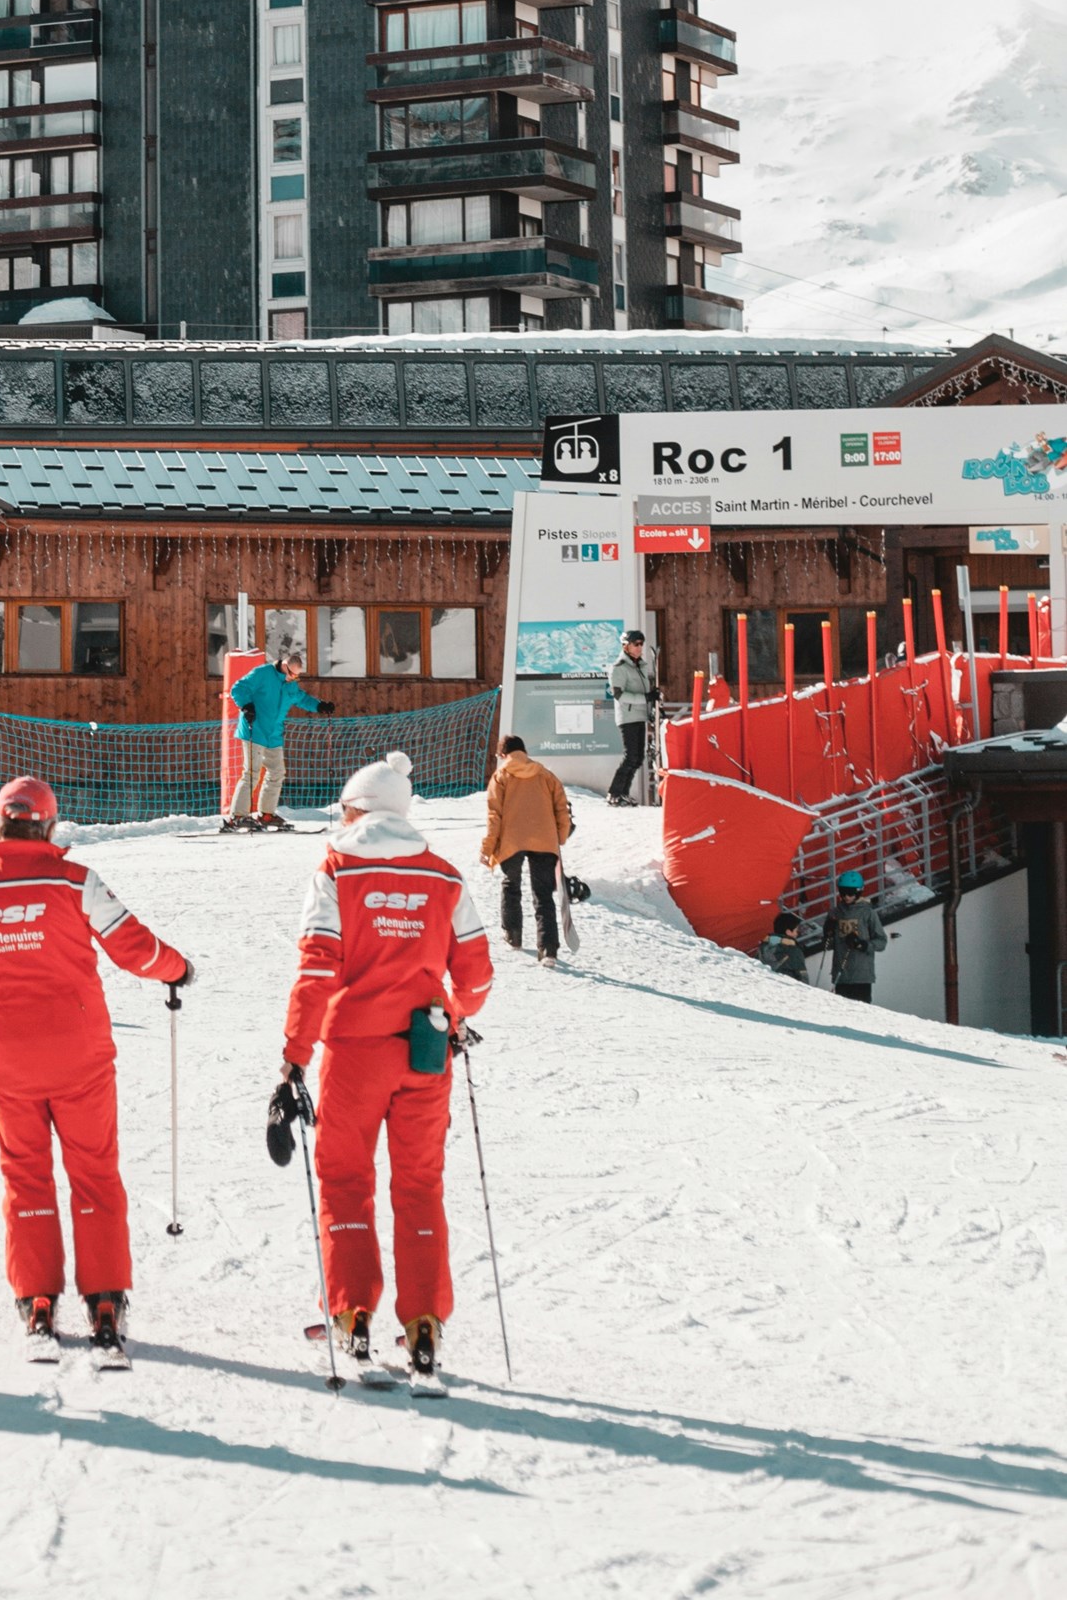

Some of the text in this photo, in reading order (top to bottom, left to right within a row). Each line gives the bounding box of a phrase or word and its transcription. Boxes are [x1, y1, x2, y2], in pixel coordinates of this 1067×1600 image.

[652, 435, 794, 476] Roc 1
[843, 452, 866, 463] 9:00
[874, 450, 901, 462] 17:00
[599, 469, 619, 483] x 8
[653, 478, 672, 486] 1810
[690, 476, 710, 485] 2306
[711, 476, 720, 484] m
[650, 502, 702, 516] ACCES
[715, 500, 747, 513] Saint
[750, 498, 791, 512] Martin
[801, 496, 849, 510] Méribel
[859, 493, 934, 508] Courchevel
[538, 529, 618, 541] Pistes Slopes
[639, 529, 668, 538] Ecoles
[675, 528, 689, 537] ski
[378, 928, 421, 938] Saint Martin
[17, 941, 41, 951] Martin
